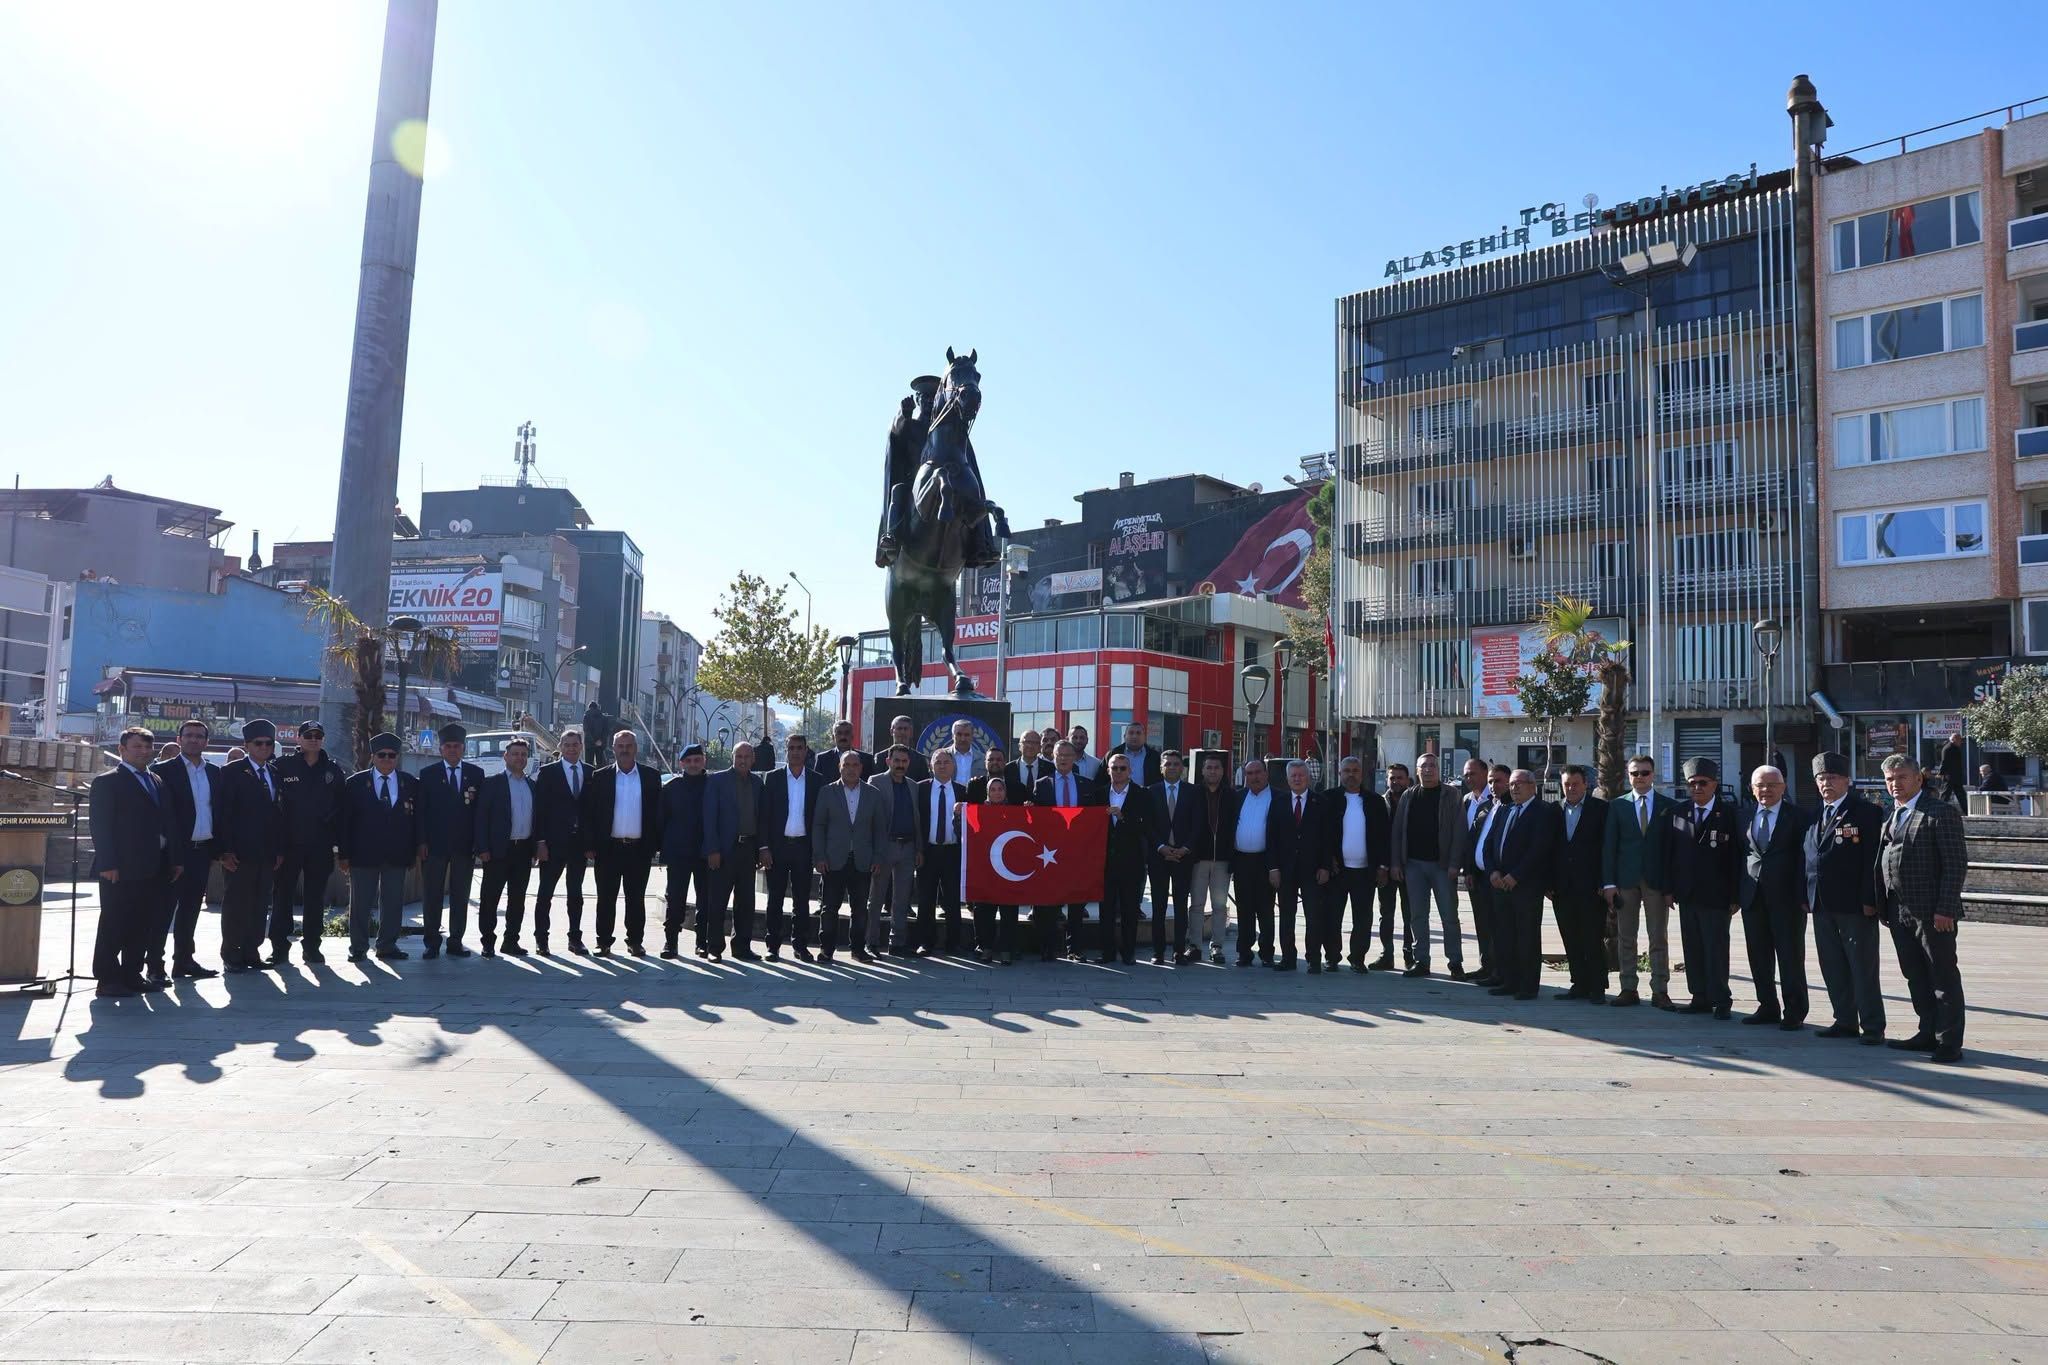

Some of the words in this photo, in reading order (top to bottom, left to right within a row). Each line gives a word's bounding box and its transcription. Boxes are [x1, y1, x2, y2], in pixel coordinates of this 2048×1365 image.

[1384, 225, 1531, 278] ALAŞEHİR
[1552, 162, 1758, 238] BELEDİYESİ
[1520, 203, 1565, 226] T.C.
[388, 584, 459, 608] EKNİK
[461, 588, 493, 607] 20
[427, 612, 495, 622] MAKİNALARI
[18, 816, 67, 824] KAYMAKAMLIĞI
